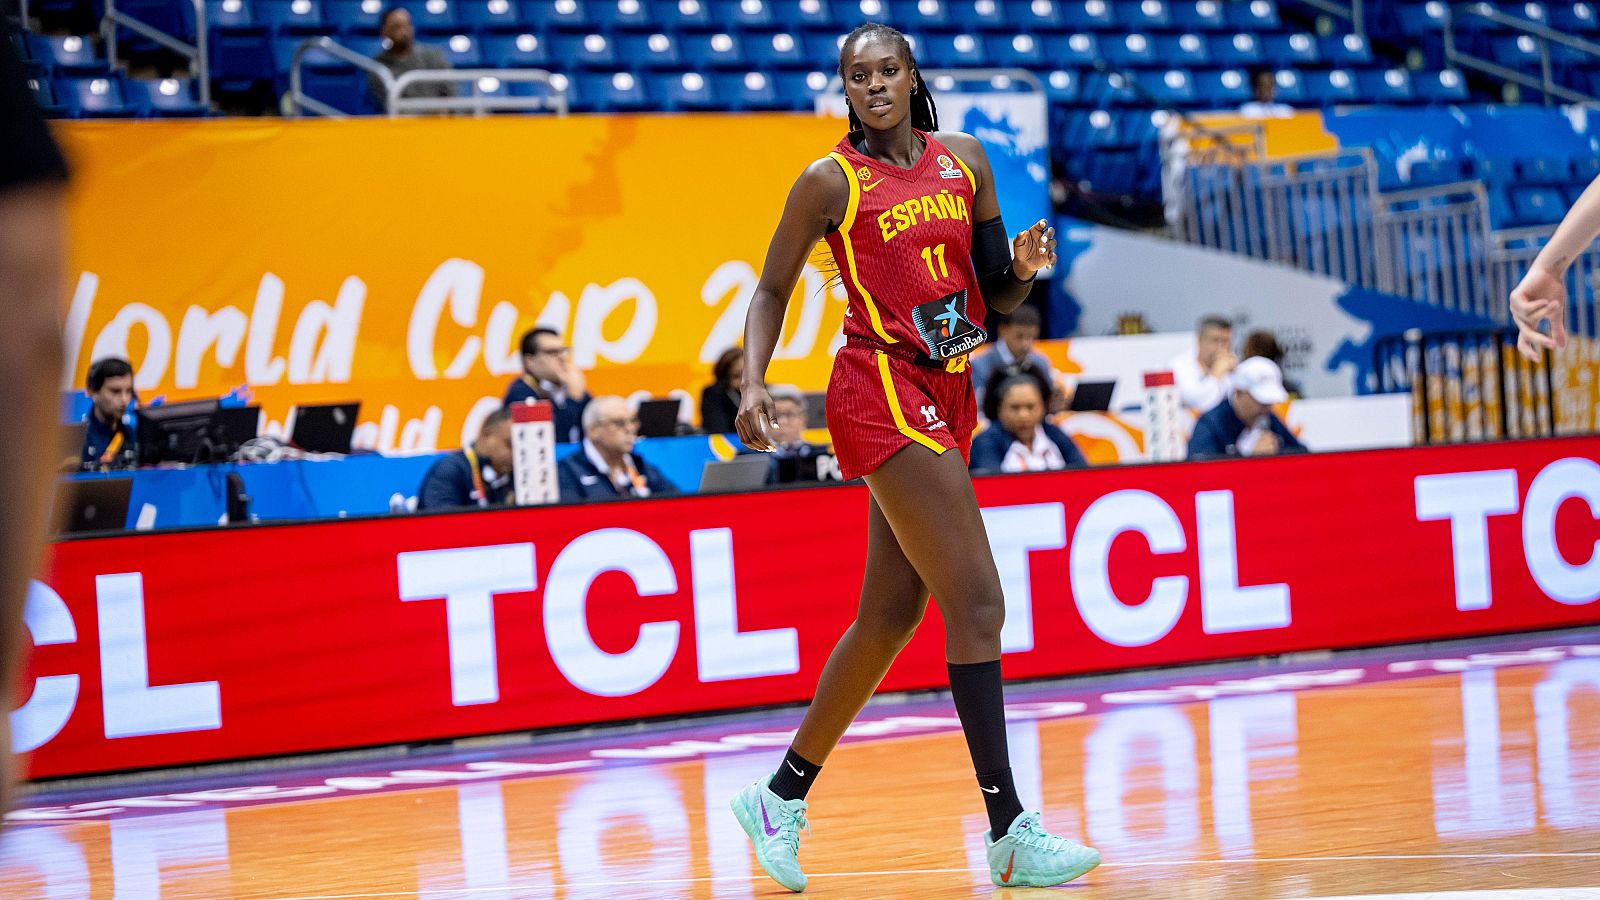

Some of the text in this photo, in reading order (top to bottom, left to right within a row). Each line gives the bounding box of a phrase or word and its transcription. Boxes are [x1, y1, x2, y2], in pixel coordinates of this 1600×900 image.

[877, 189, 970, 243] ESPAÑA
[921, 243, 949, 282] 11
[406, 257, 659, 380] Cup
[698, 259, 848, 364] 20
[940, 330, 984, 358] CaixaBank
[980, 488, 1293, 655] TCL
[396, 527, 800, 707] TCL
